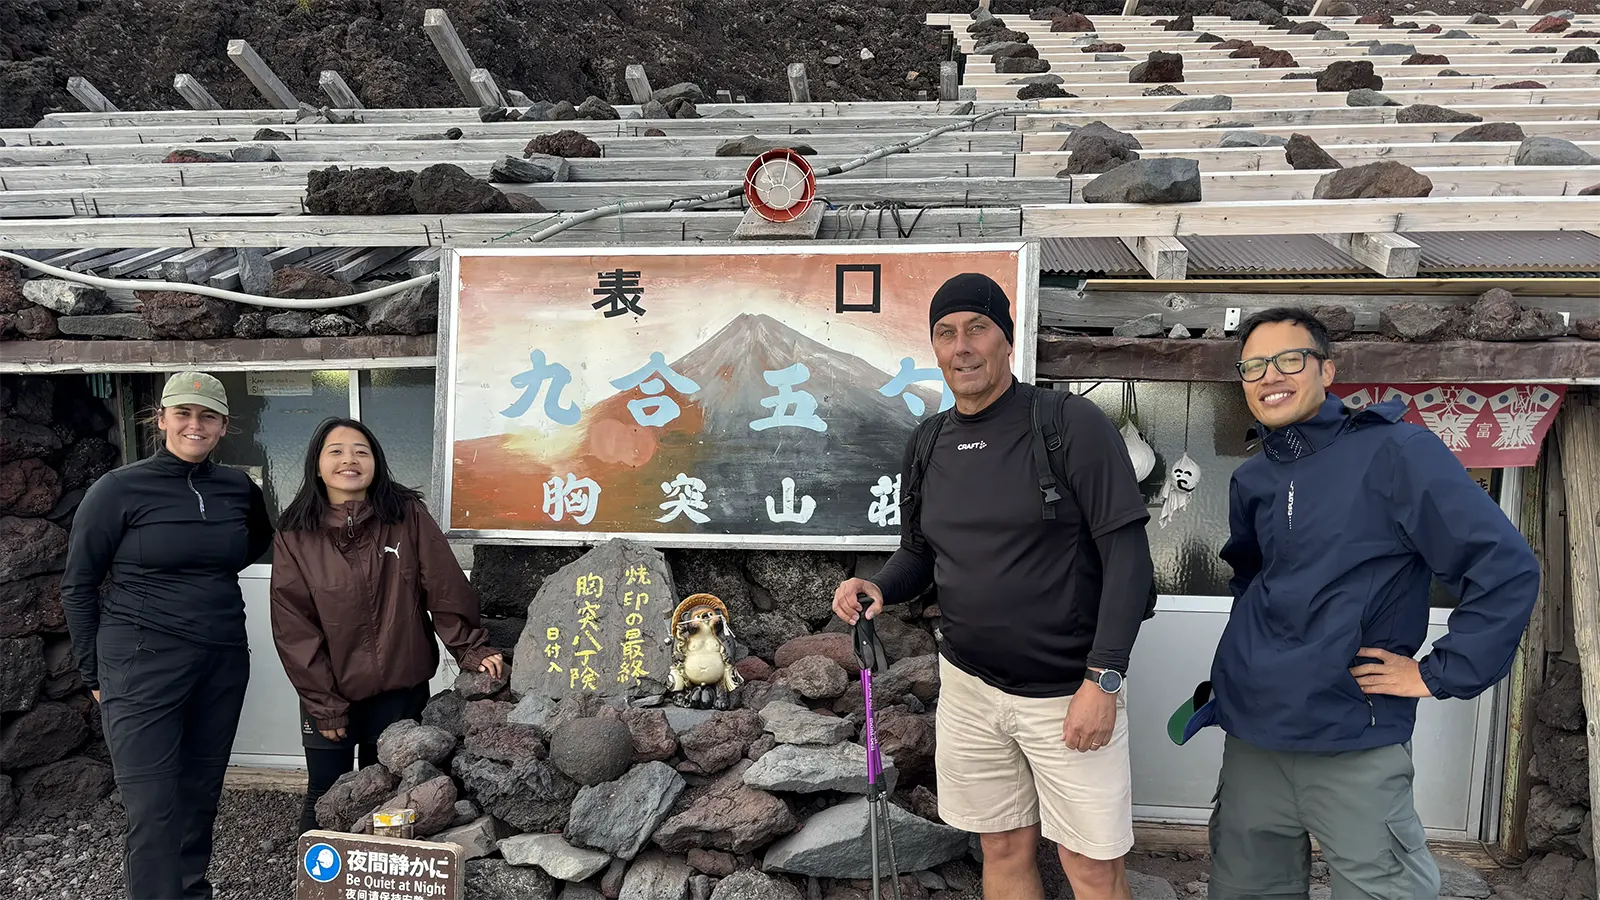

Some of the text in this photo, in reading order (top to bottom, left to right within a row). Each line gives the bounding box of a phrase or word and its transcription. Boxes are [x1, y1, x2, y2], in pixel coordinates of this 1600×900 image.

[957, 442, 980, 450] CRAFT
[347, 850, 449, 879] 夜間静かに
[346, 873, 447, 896] Be Quiet at Night
